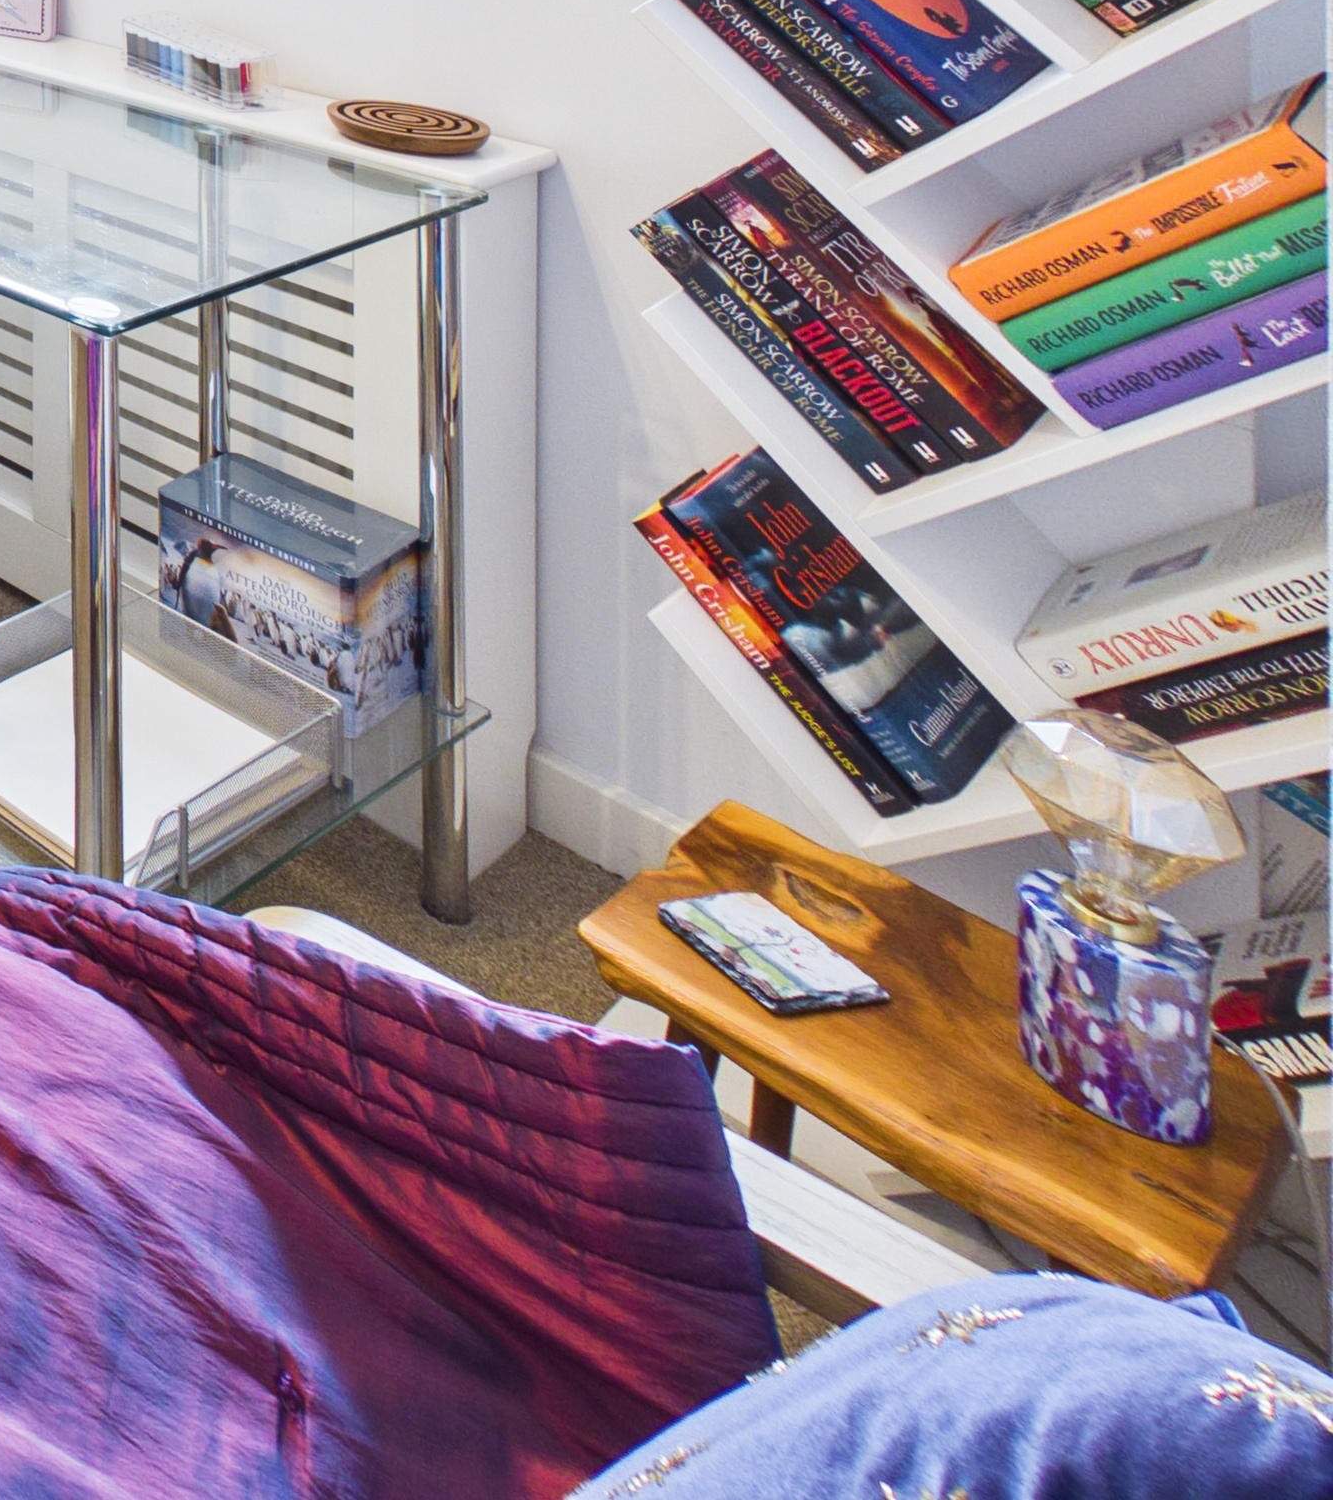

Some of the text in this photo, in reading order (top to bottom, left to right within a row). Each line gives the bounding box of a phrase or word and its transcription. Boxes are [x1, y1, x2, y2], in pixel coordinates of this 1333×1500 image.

[698, 2, 783, 82] WARRIOR
[789, 8, 873, 78] SCARROW
[803, 83, 853, 128] ANDREWS
[820, 57, 872, 99] EXILE
[784, 193, 838, 234] SCAR
[686, 218, 779, 305] SCARROW
[715, 225, 779, 285] SIMON
[821, 231, 878, 274] TYR
[1046, 241, 1109, 278] OSMAN
[1210, 253, 1262, 290] Bullet
[764, 248, 925, 405] TYRANT OF ROME
[790, 254, 930, 386] SIMON SCARROW
[1100, 289, 1169, 326] OSMAN
[1261, 315, 1314, 348] Last
[686, 276, 846, 444] THE HONOUR OF ROME
[714, 293, 845, 421] SIMON SCARROW
[793, 320, 922, 434] BLACKOUT
[1153, 345, 1224, 382] OSMAN
[745, 500, 813, 560] John
[225, 568, 347, 634] ATTENBOROUGH
[261, 574, 309, 604] DAVID
[684, 514, 723, 555] John
[721, 556, 786, 628] Grisham
[773, 534, 864, 611] Grisham
[648, 533, 695, 583] John
[694, 583, 772, 671] Grisham
[769, 673, 793, 698] THE
[789, 695, 837, 750] JUDGE'S
[833, 745, 863, 778] LIST
[1077, 614, 1220, 675] UNRULY
[1231, 663, 1265, 683] THE
[1144, 667, 1236, 712] EMPEROR
[1185, 682, 1291, 726] SCARROW
[1241, 1031, 1332, 1079] SMAN
